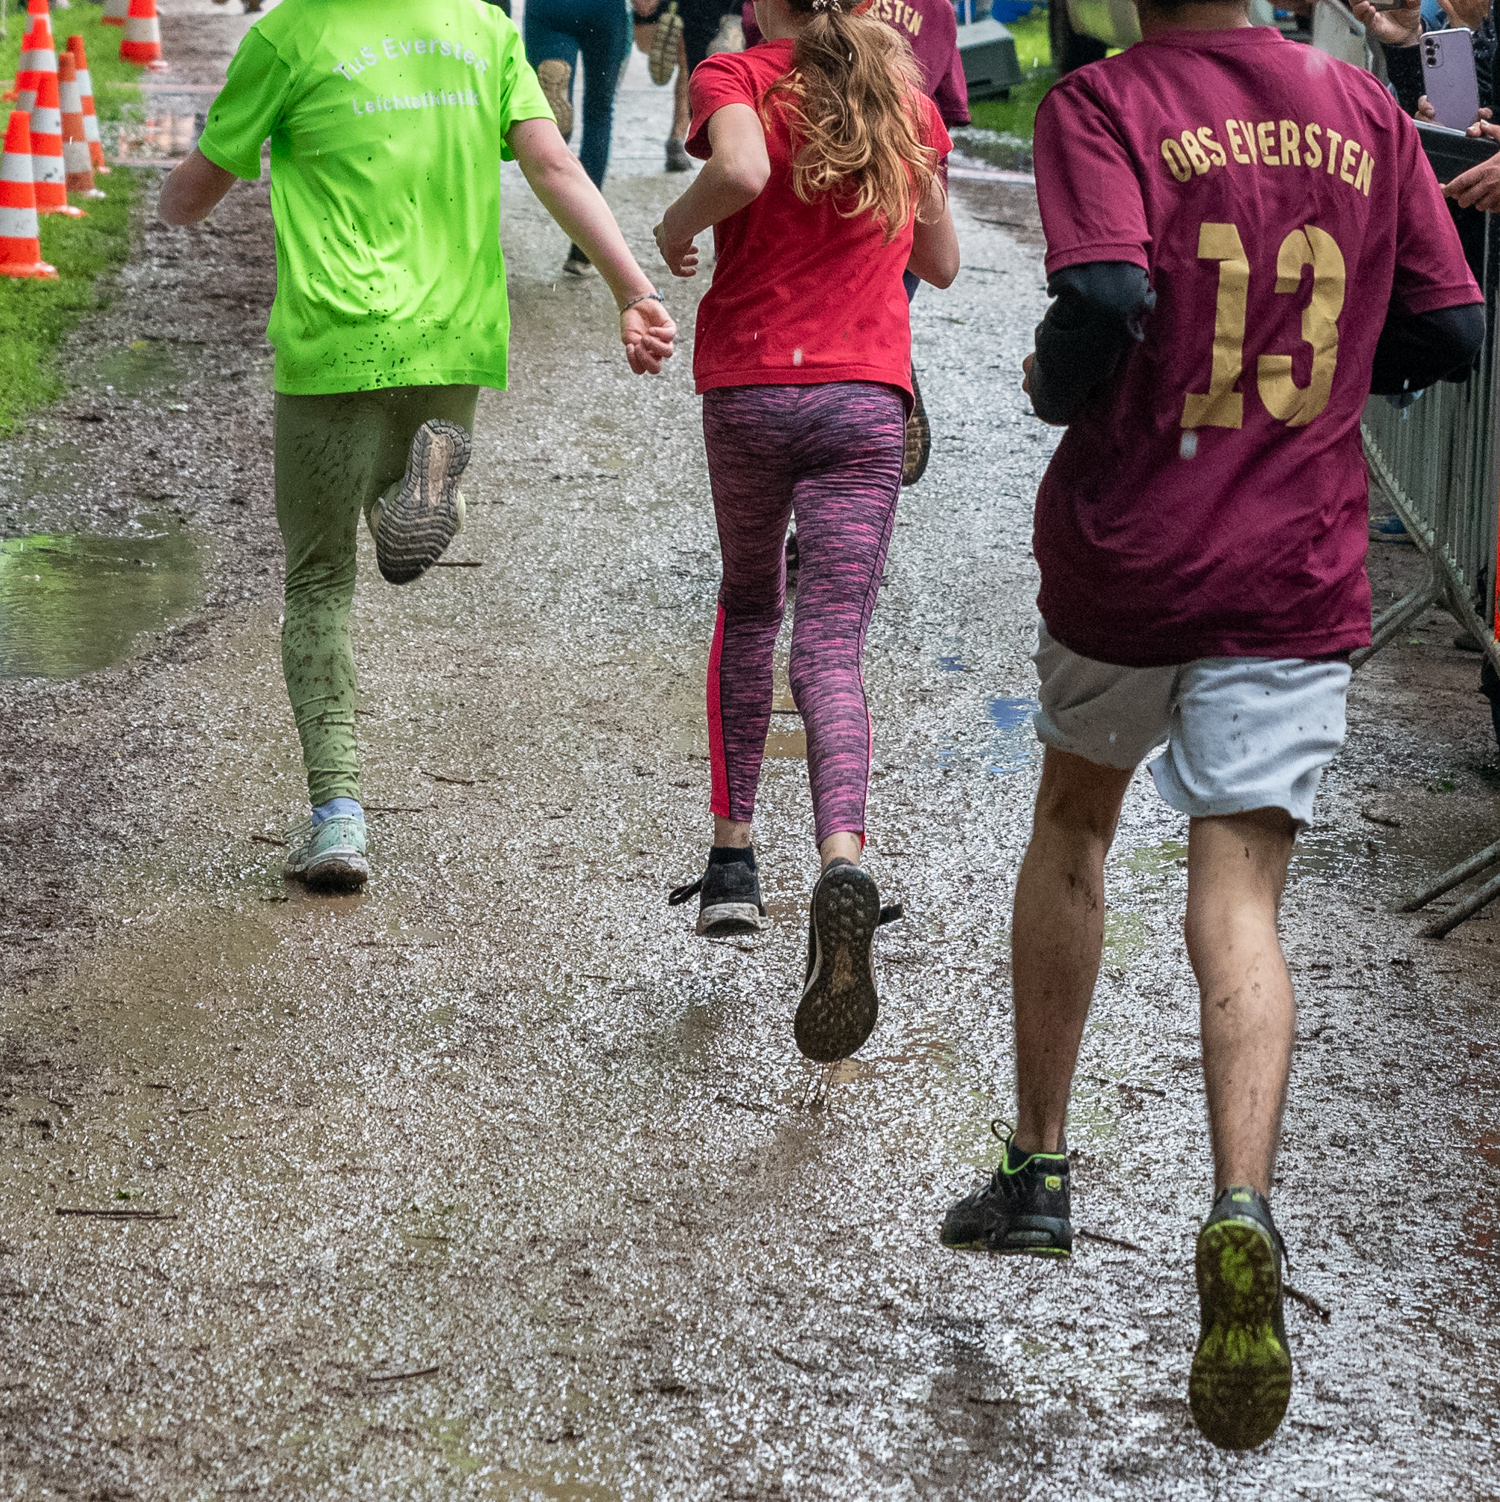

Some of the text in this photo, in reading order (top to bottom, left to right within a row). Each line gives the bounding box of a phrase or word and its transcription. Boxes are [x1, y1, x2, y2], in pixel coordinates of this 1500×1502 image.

[332, 38, 487, 81] TuS Eversten
[352, 89, 480, 116] Leichtathletik
[1160, 118, 1376, 198] OBS EVERSTEN
[1180, 222, 1347, 430] 13
